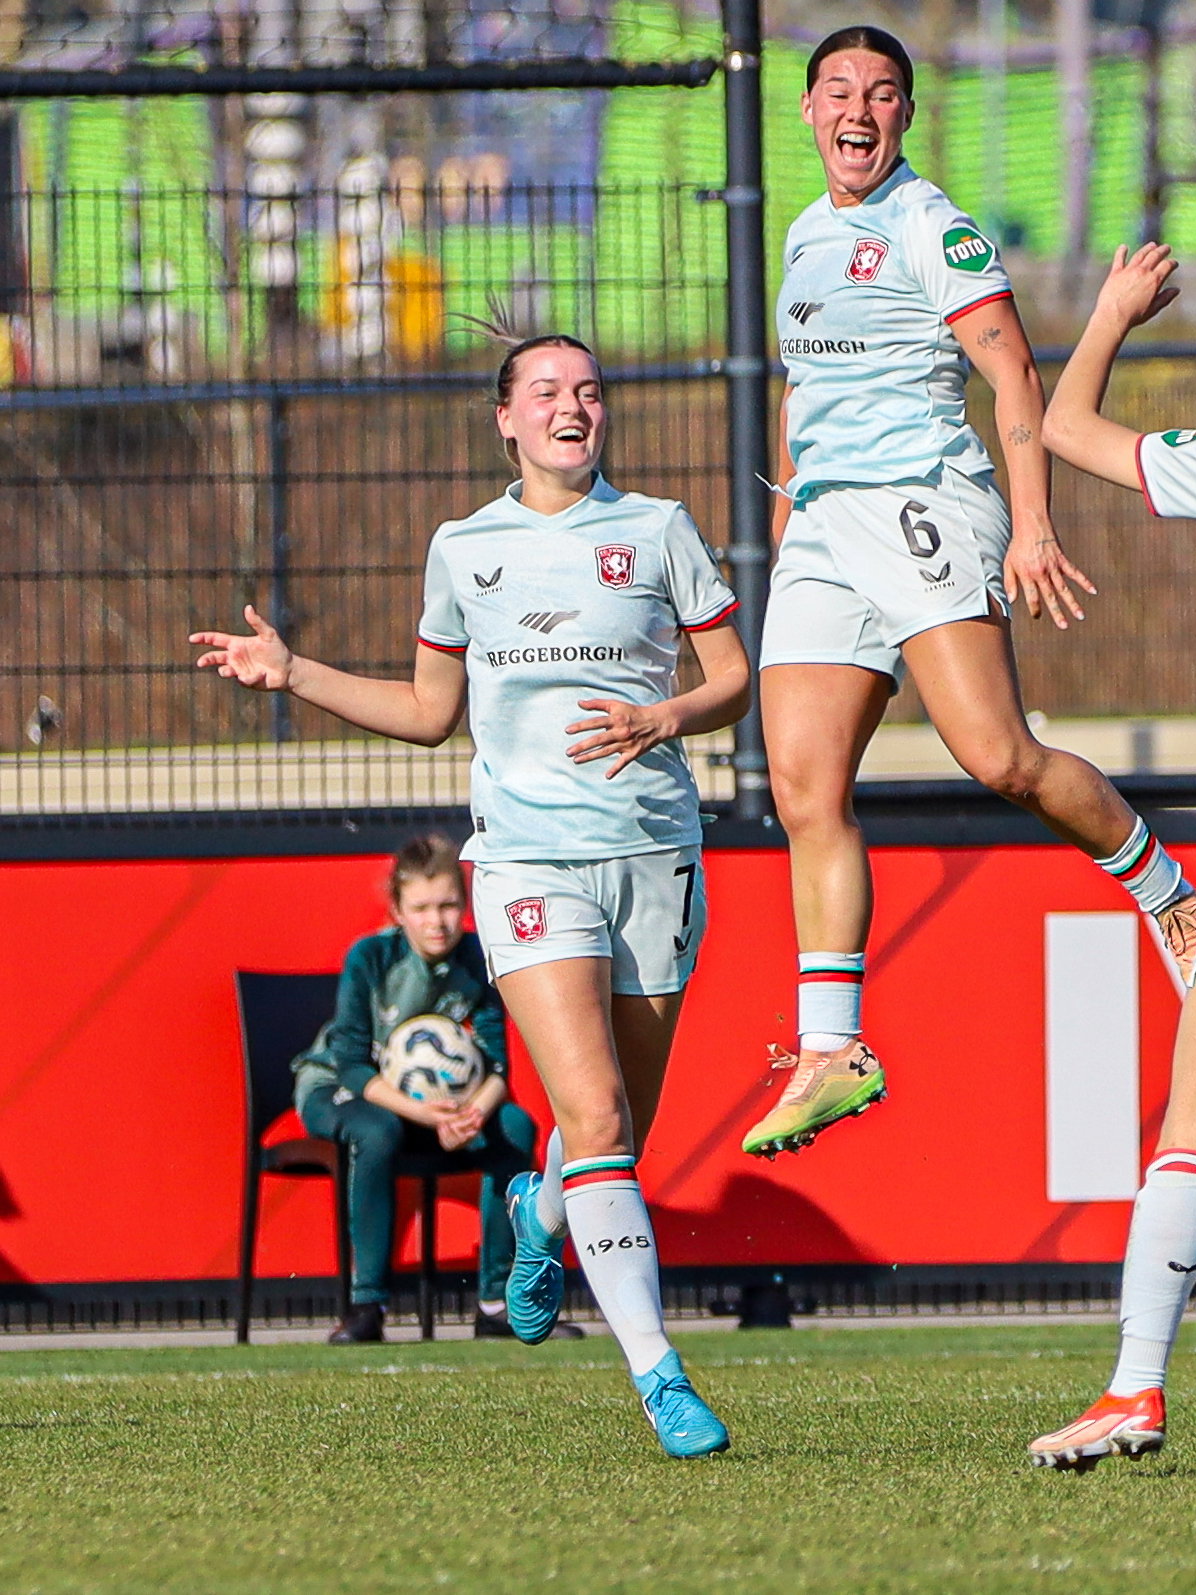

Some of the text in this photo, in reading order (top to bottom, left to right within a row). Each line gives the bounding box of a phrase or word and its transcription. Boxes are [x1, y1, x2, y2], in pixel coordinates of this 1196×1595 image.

[945, 238, 987, 264] TOTO
[780, 338, 866, 354] GGEBORGH
[899, 499, 942, 558] 6
[486, 646, 623, 667] REGGEBORGH
[673, 861, 697, 928] 7
[586, 1235, 651, 1257] 1965
